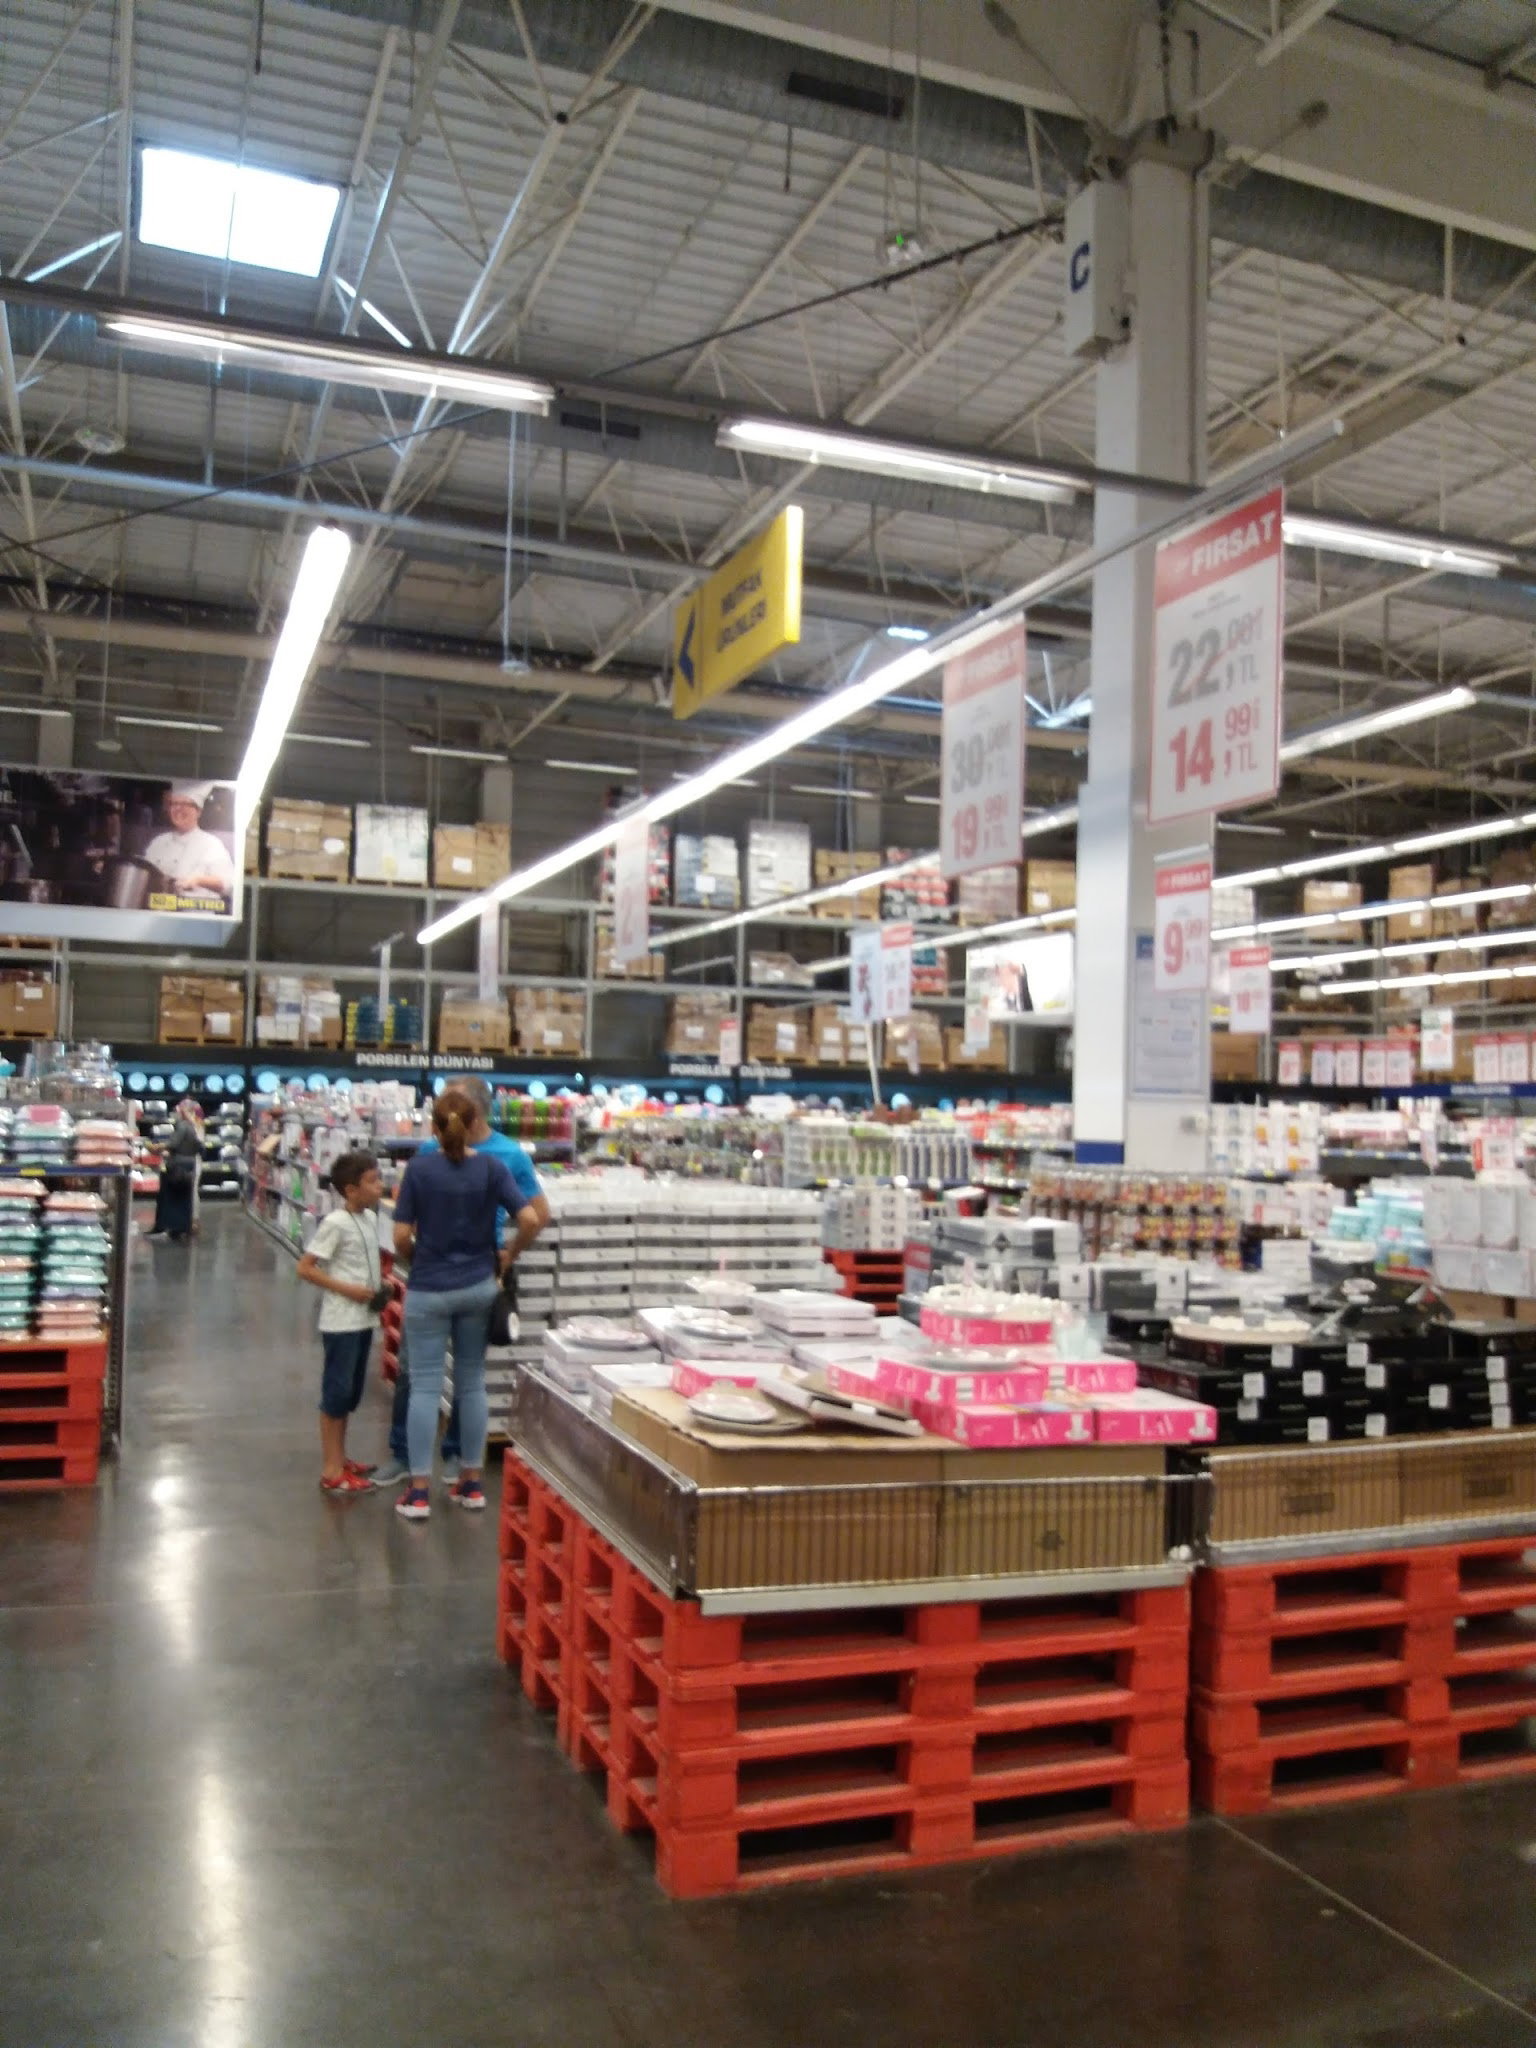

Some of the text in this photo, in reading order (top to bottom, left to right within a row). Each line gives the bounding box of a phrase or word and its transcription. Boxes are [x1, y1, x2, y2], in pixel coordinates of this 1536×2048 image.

[1070, 241, 1090, 294] C
[1190, 513, 1274, 577] FIRSAT
[1168, 628, 1222, 708] 22
[1168, 718, 1214, 794] 14
[1163, 920, 1184, 976] 9
[356, 1052, 430, 1067] PORSELEN
